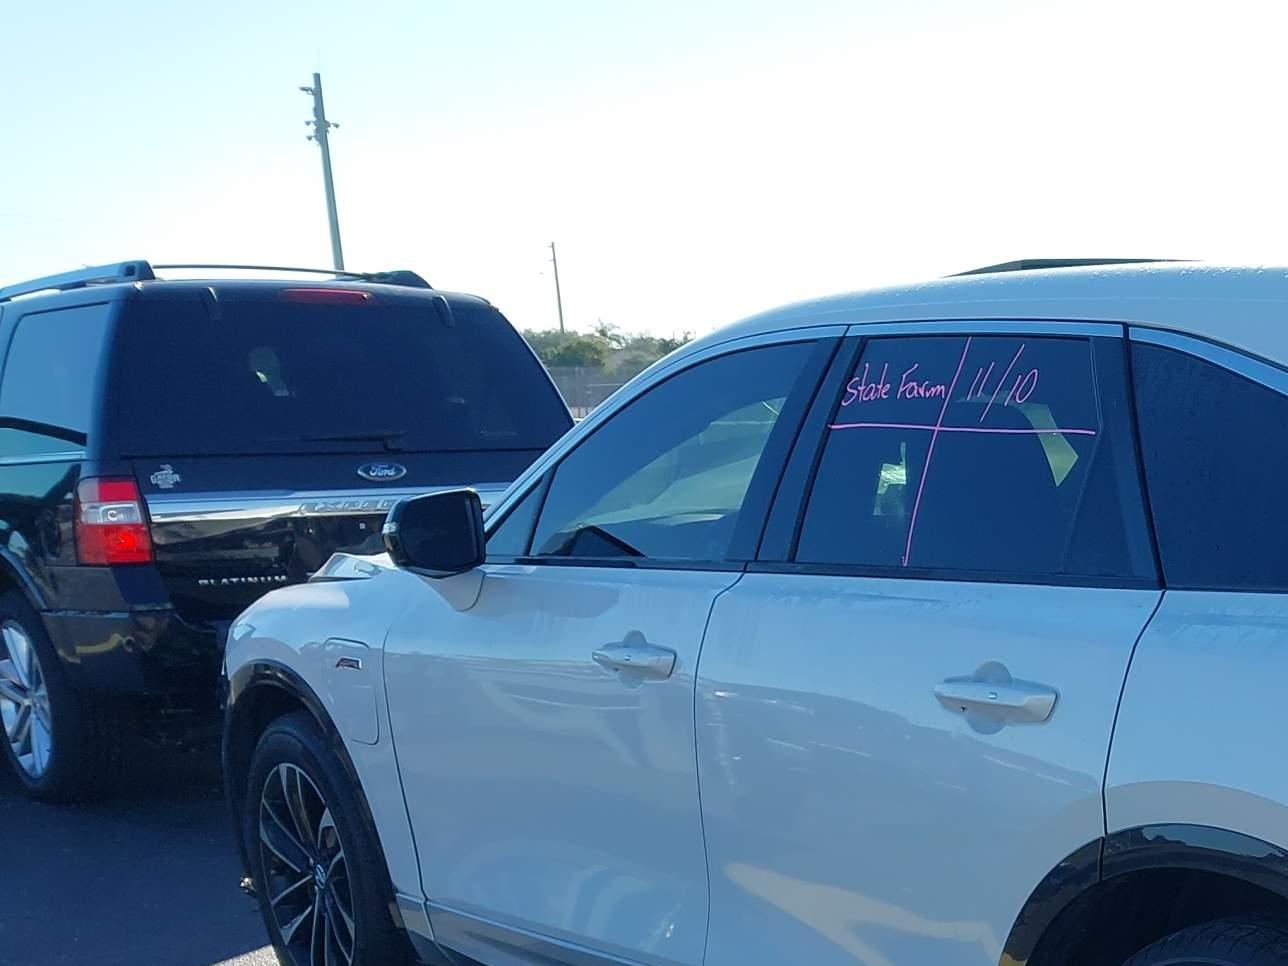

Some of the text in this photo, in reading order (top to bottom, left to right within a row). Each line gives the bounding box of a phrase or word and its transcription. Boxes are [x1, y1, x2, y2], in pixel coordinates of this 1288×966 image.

[841, 344, 1039, 423] State Farm 11/10
[198, 575, 287, 585] PLATINUM
